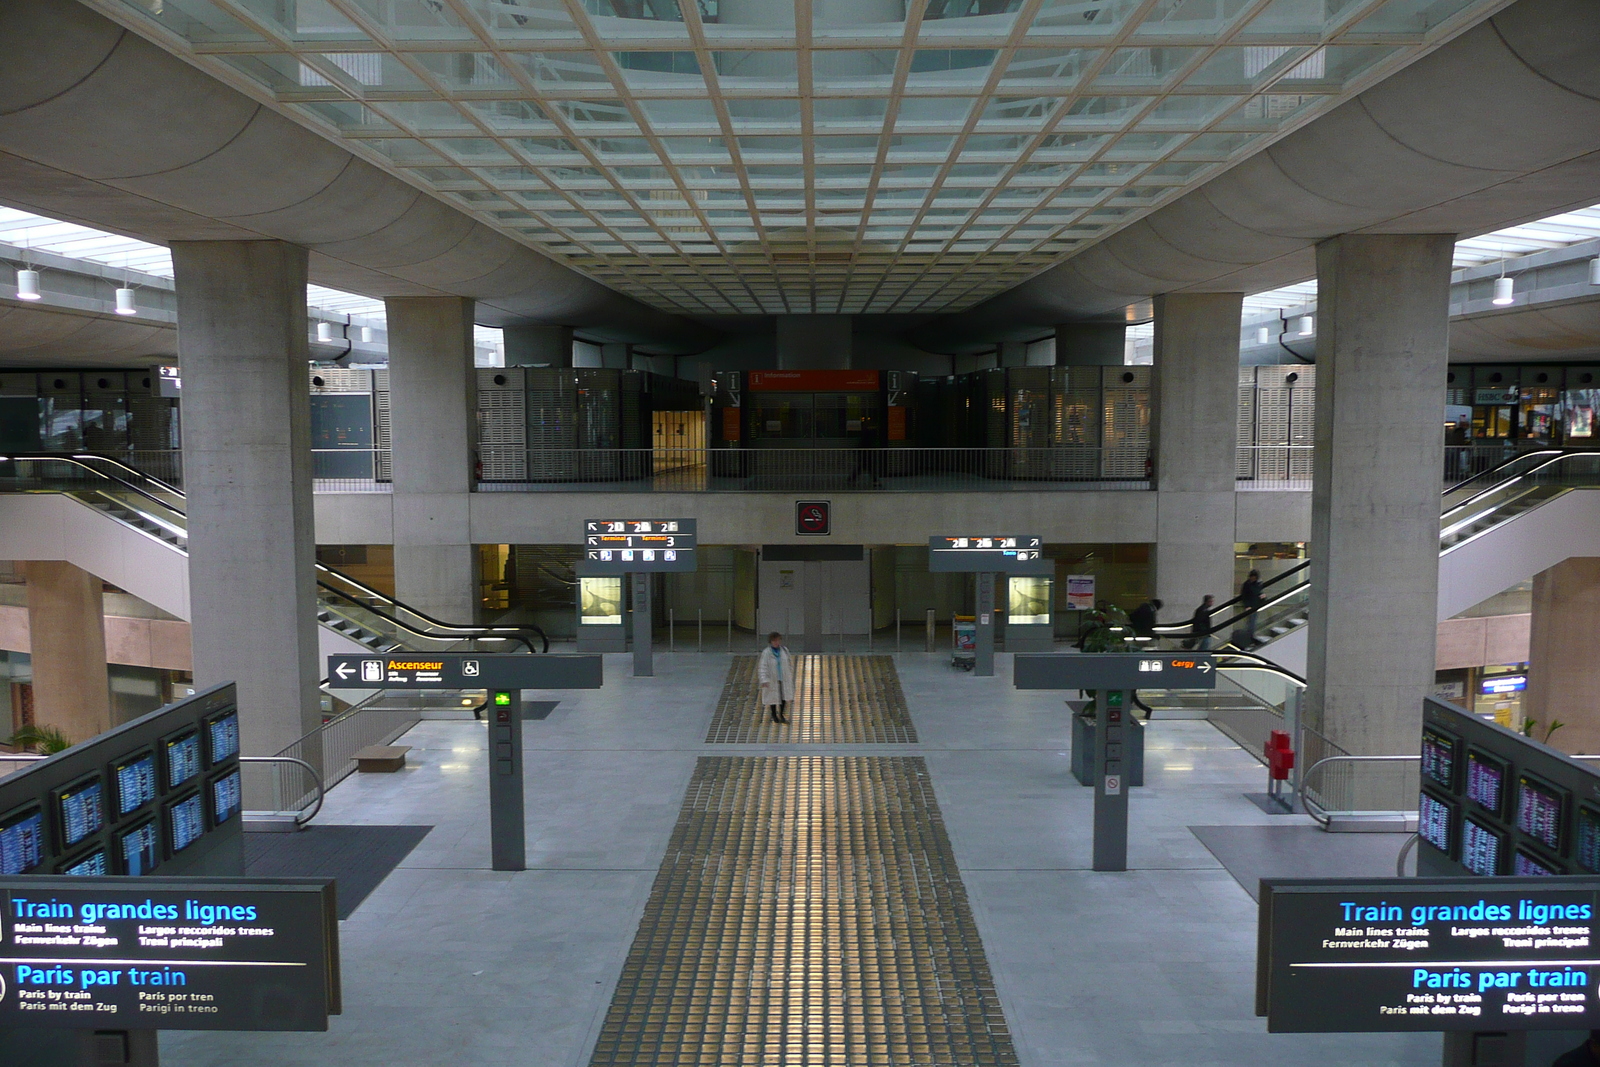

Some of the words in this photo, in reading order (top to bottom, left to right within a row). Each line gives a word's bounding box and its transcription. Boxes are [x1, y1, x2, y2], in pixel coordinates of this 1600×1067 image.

[626, 536, 632, 547] 1
[666, 536, 675, 547] 3
[388, 660, 443, 670] Ascenseur
[1172, 660, 1195, 668] Cergy
[12, 899, 73, 919] Train
[81, 900, 178, 923] grandes
[186, 900, 256, 925] lignes
[1341, 902, 1401, 921] Train
[1411, 901, 1510, 925] grandes
[1519, 900, 1591, 925] lignes
[15, 924, 42, 932] Main
[45, 924, 71, 933] lines
[73, 925, 106, 934] trains
[139, 926, 176, 937] Largos
[238, 927, 273, 936] trenes
[1335, 928, 1363, 936] Main
[1367, 927, 1393, 936] lines
[1397, 928, 1429, 936] trains
[1452, 927, 1490, 937] Largos
[1553, 926, 1589, 934] trenes
[139, 937, 168, 946] Treni
[171, 937, 223, 948] principali
[1323, 939, 1389, 948] Fernverkehr
[1392, 939, 1428, 950] Zügen
[18, 965, 73, 984] Paris
[82, 970, 121, 988] par
[129, 967, 186, 986] train
[1413, 968, 1470, 987] Paris
[1479, 972, 1521, 991] par
[1528, 968, 1586, 986] train
[19, 991, 45, 999] Paris
[49, 991, 61, 1001] by
[64, 991, 91, 999] train
[169, 994, 188, 1003] por
[191, 993, 213, 1001] tren
[1407, 994, 1433, 1002] Paris
[1437, 994, 1450, 1004] by
[1454, 994, 1481, 1002] train
[1538, 994, 1558, 1003] por
[1561, 993, 1585, 1001] tren
[20, 1002, 45, 1010] Paris
[49, 1002, 67, 1010] mit
[70, 1002, 94, 1011] dem
[97, 1003, 117, 1013] Zug
[139, 1004, 171, 1014] Parigi
[174, 1004, 185, 1012] in
[188, 1005, 218, 1013] treno
[1380, 1006, 1406, 1014] Paris
[1410, 1005, 1429, 1014] mit
[1432, 1005, 1456, 1014] dem
[1459, 1005, 1481, 1016] Zug
[1503, 1005, 1535, 1015] Parigi
[1538, 1005, 1550, 1013] in
[1552, 1005, 1584, 1013] treno
